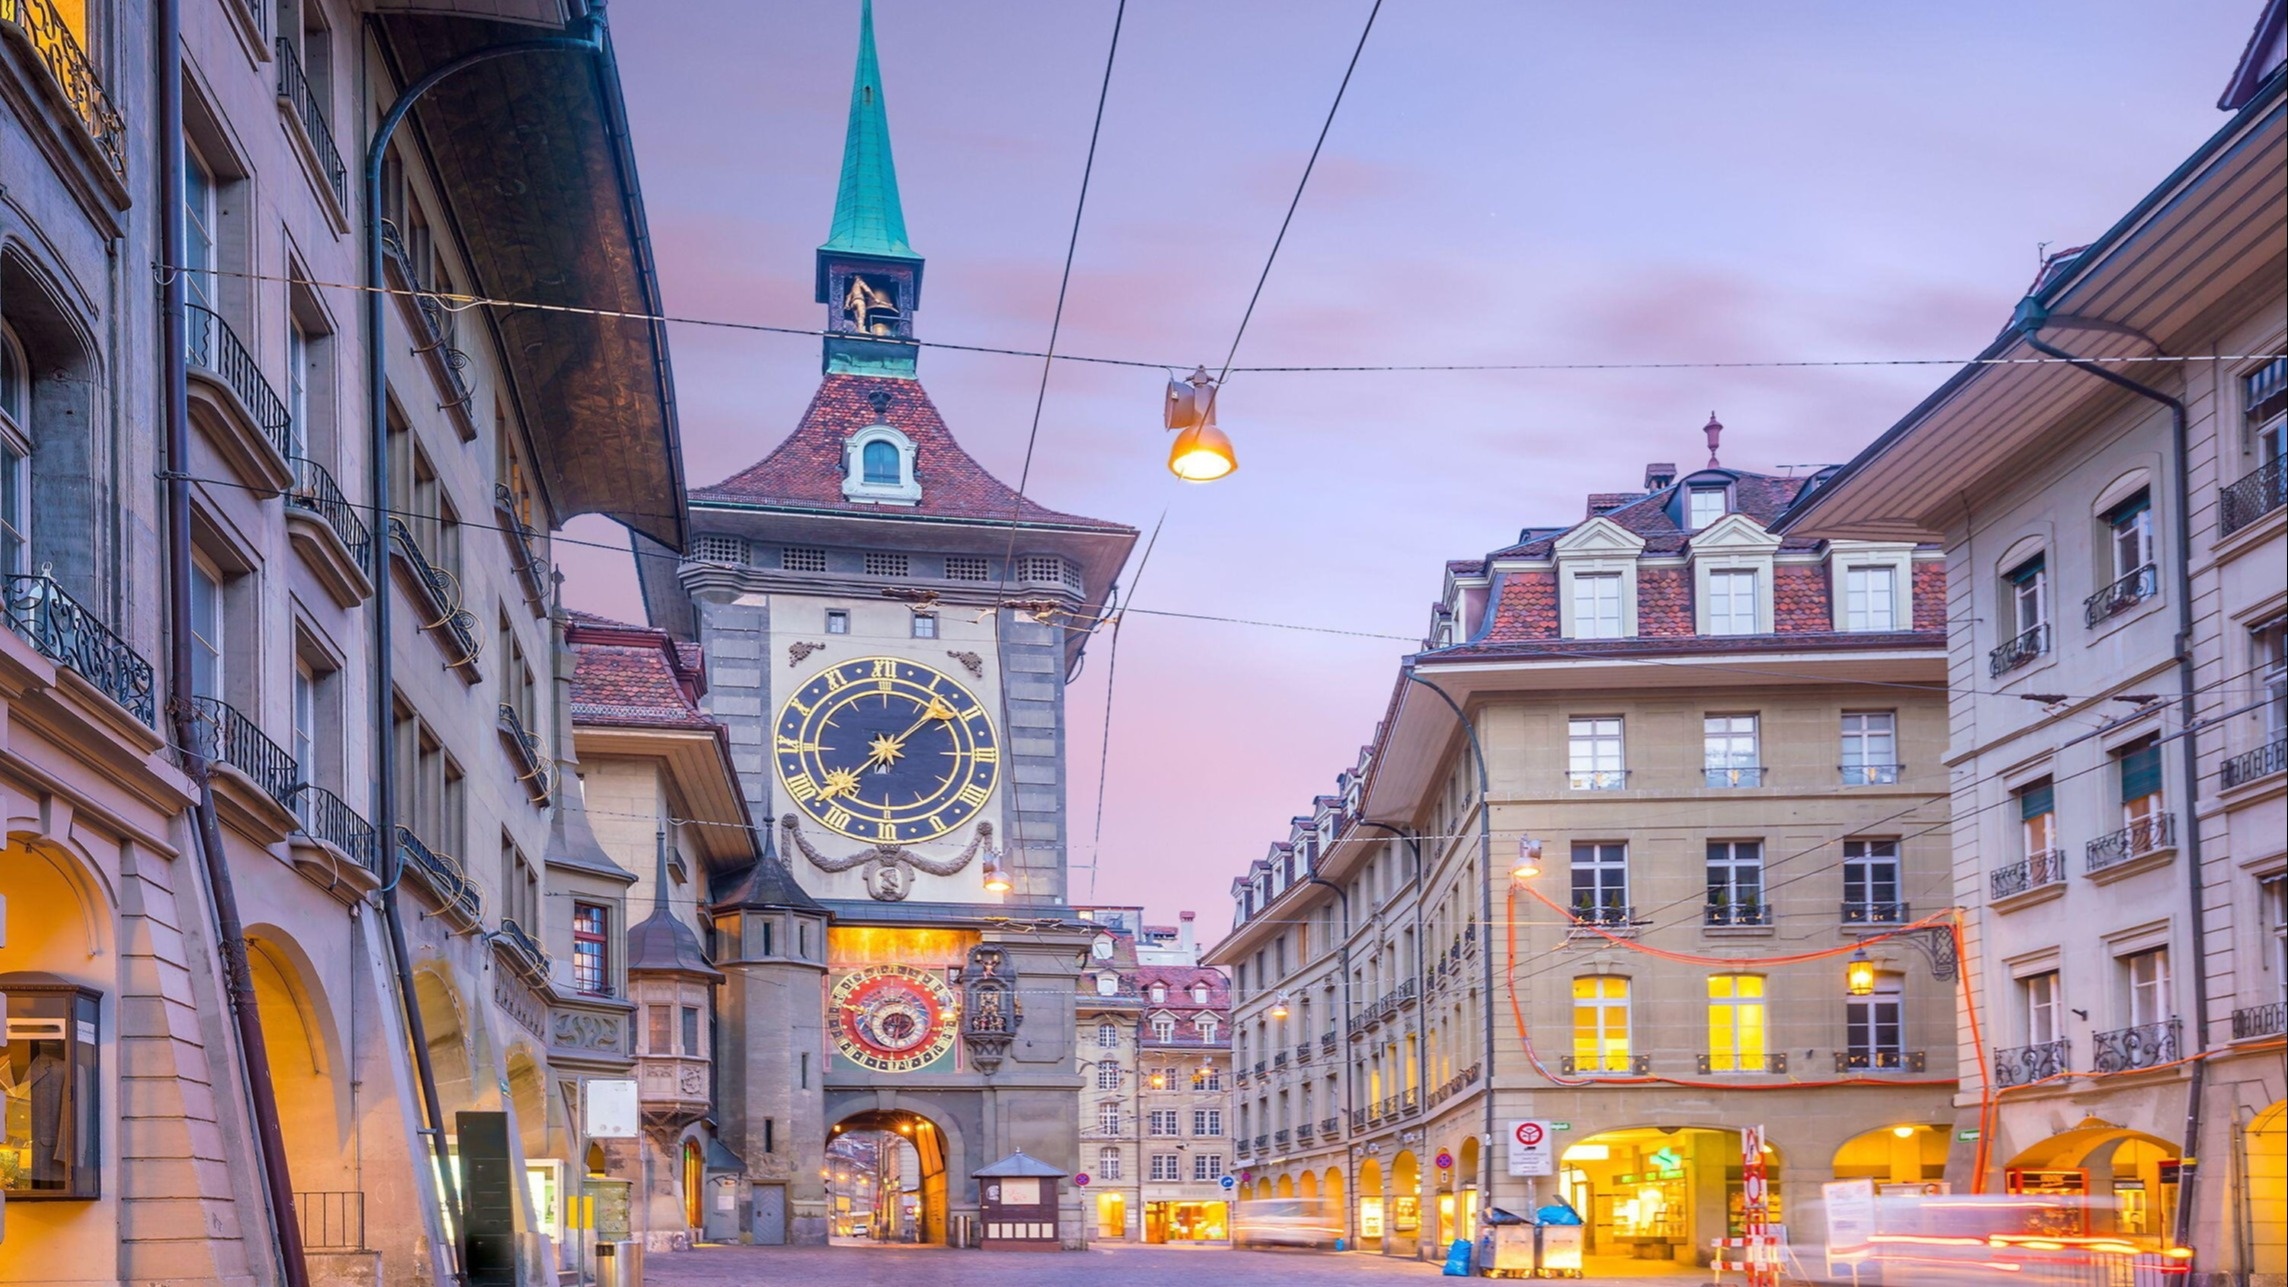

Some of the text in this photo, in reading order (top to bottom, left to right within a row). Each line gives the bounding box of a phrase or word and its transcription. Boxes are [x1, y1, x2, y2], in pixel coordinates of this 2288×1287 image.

[871, 660, 898, 678] XII
[825, 668, 848, 691] XI
[928, 675, 941, 691] I
[790, 698, 811, 717] X
[961, 705, 984, 722] II
[778, 734, 800, 754] IX
[974, 747, 997, 763] III
[786, 772, 816, 802] VIII
[959, 783, 988, 808] IIII
[823, 806, 852, 830] VII
[878, 823, 897, 840] VI
